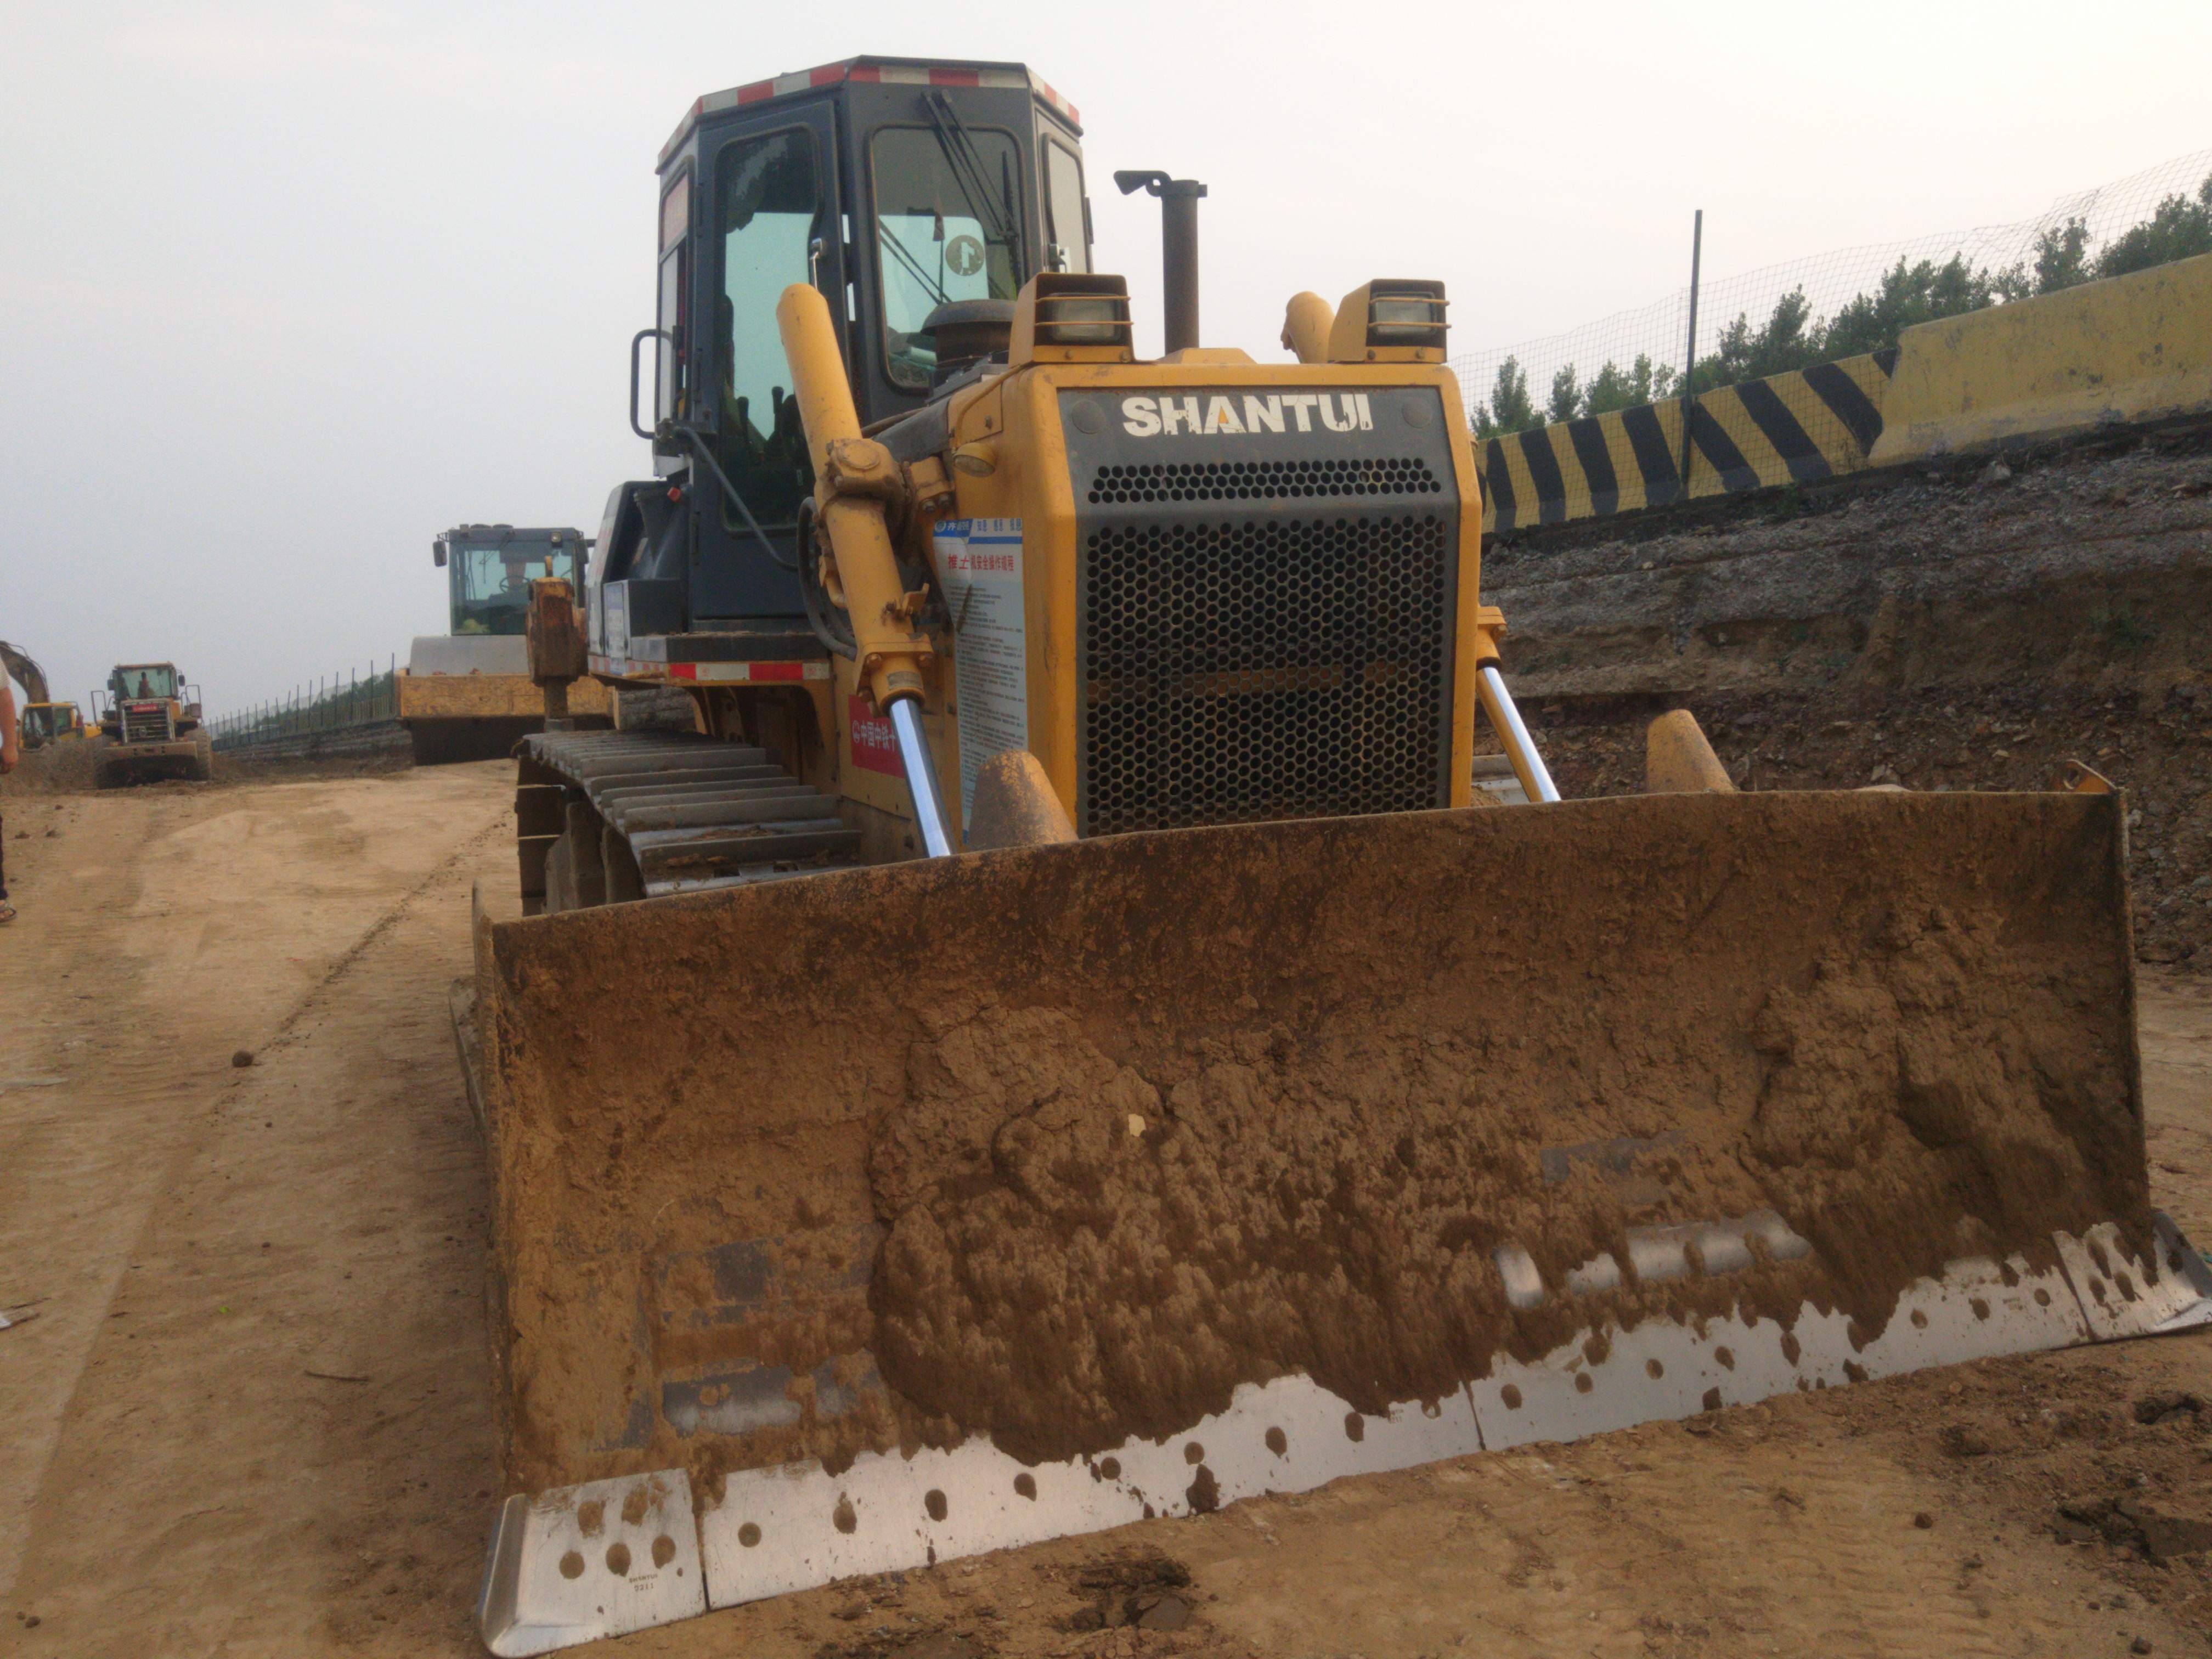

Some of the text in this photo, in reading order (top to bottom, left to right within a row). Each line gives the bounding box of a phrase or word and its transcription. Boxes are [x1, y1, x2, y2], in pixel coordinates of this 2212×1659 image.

[1121, 393, 1373, 437] SHANTUI
[948, 554, 1014, 571] 推土机安全操作规程
